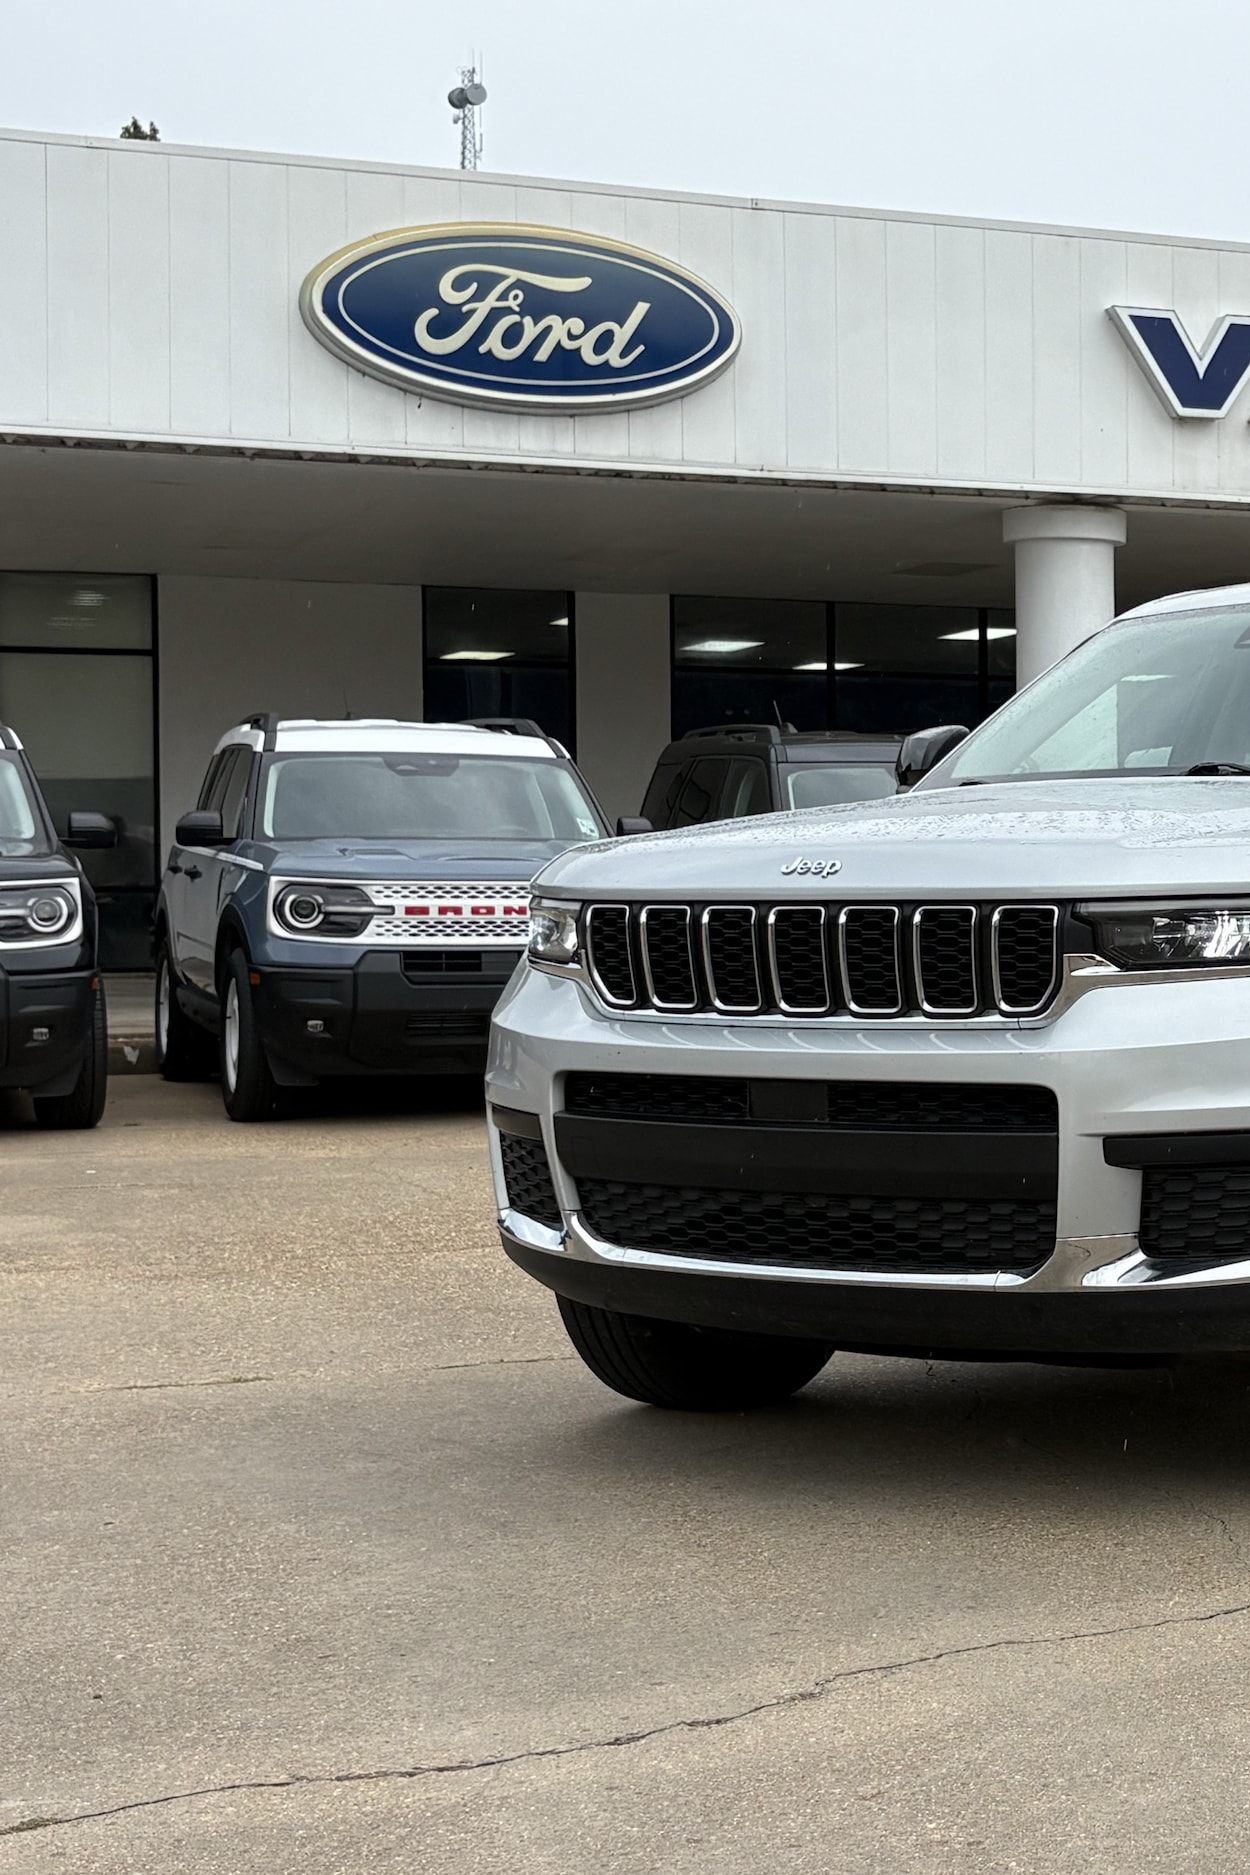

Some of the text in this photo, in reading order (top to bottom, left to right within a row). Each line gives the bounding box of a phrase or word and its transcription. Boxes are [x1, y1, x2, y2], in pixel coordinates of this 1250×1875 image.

[414, 263, 652, 369] Ford
[780, 856, 843, 879] Jeep
[404, 905, 528, 916] BRON
